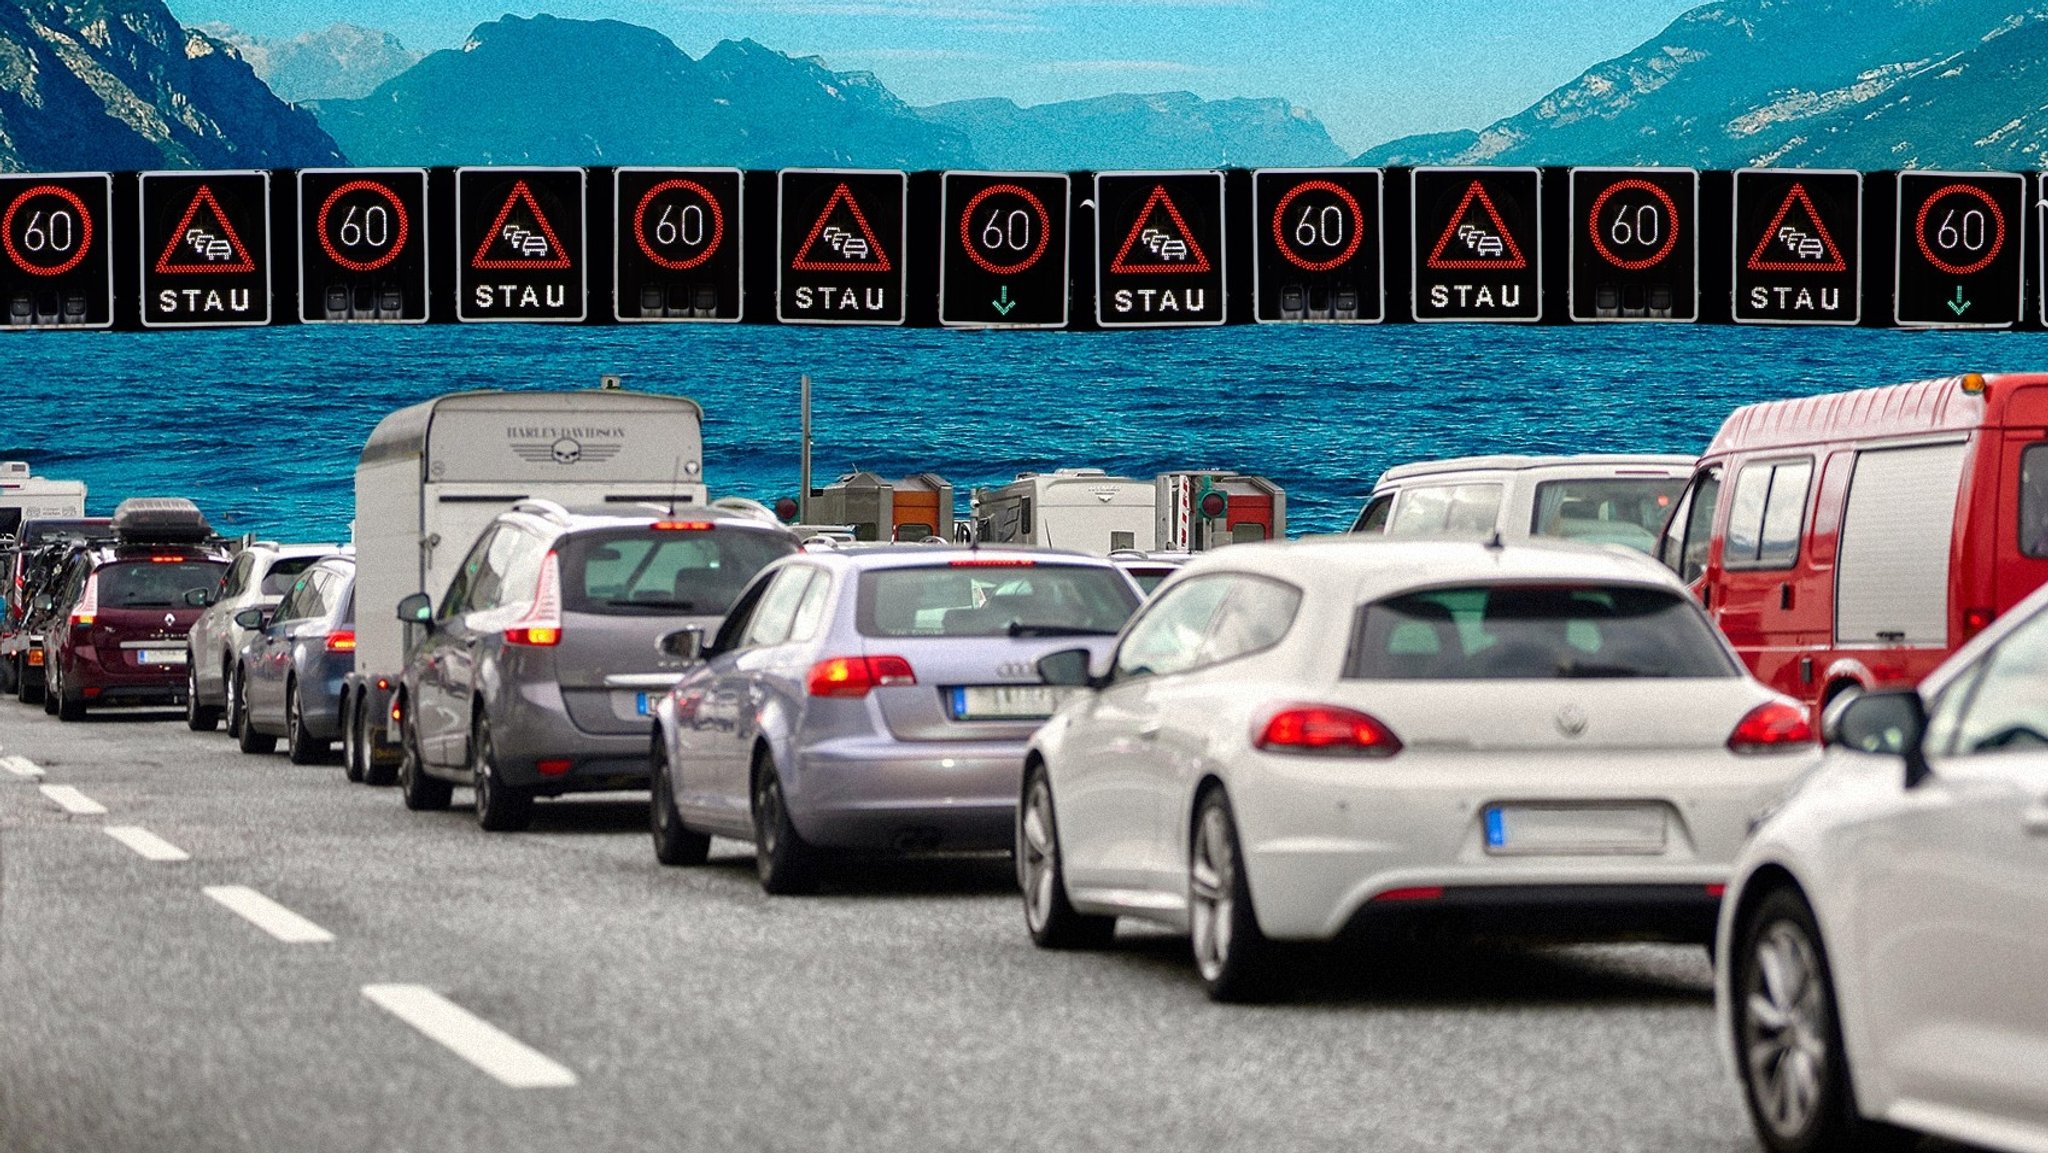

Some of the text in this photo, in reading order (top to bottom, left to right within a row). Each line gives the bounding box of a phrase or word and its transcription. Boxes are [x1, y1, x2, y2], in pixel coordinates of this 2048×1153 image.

[24, 210, 72, 251] 60
[340, 206, 388, 247] 60
[655, 205, 703, 246] 60
[982, 210, 1030, 250] 60
[1295, 206, 1343, 247] 60
[1611, 205, 1658, 246] 60
[1938, 210, 1985, 250] 60
[159, 289, 249, 313] STAU
[475, 285, 565, 308] STAU
[795, 287, 884, 311] STAU
[1114, 289, 1205, 313] STAU
[1431, 285, 1520, 308] STAU
[1750, 287, 1839, 311] STAU
[507, 427, 557, 438] HARLEY
